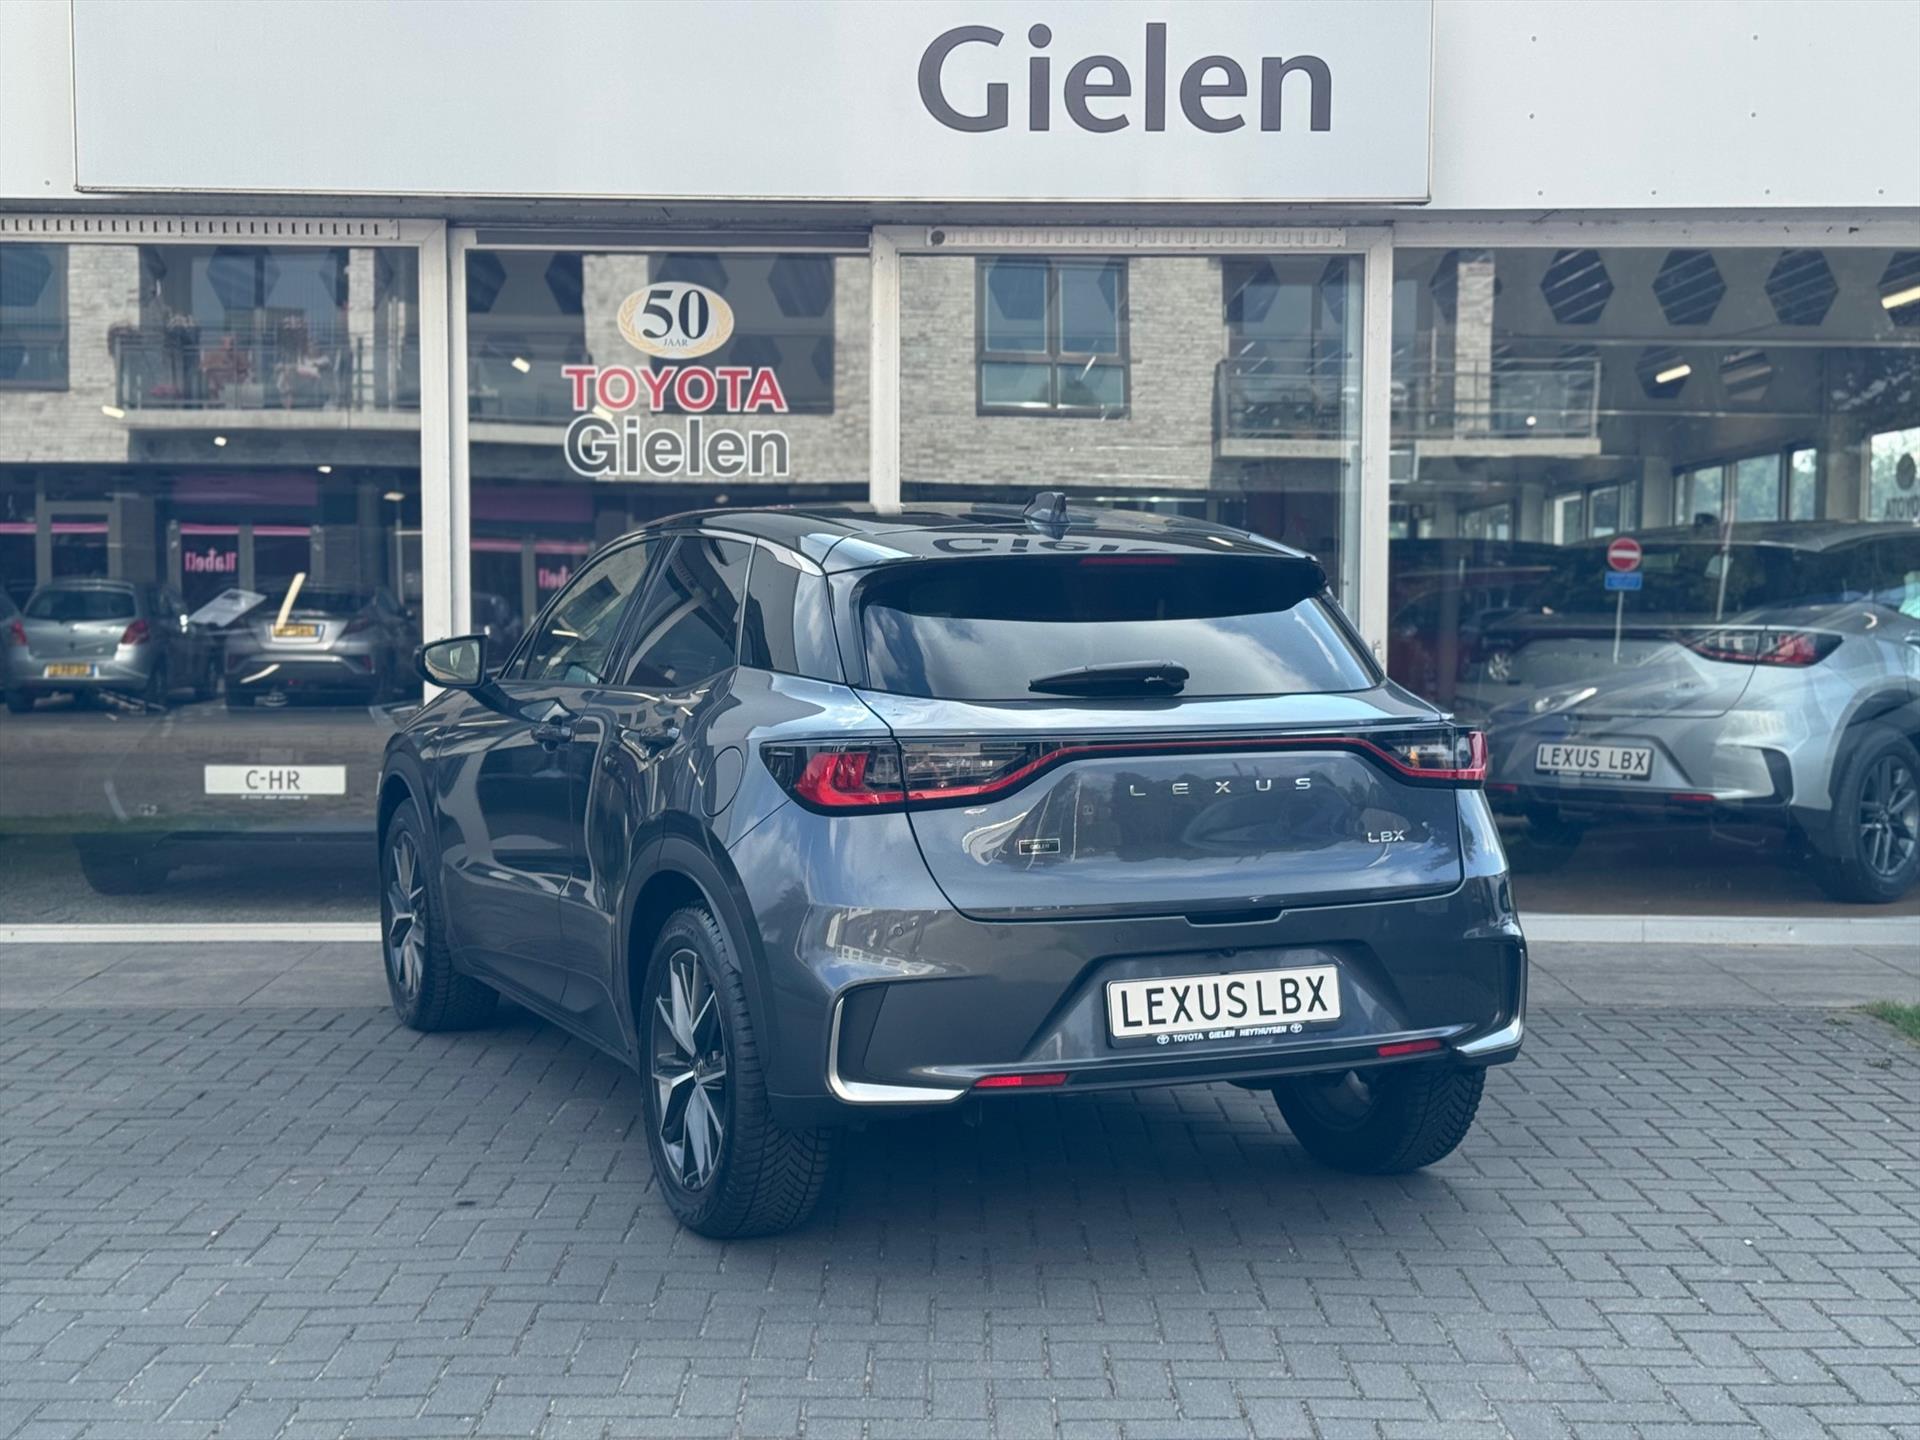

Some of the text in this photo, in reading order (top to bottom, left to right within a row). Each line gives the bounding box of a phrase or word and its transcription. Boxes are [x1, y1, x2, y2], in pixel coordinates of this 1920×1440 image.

[918, 23, 1332, 133] Gielen
[642, 289, 710, 340] 50
[664, 338, 688, 348] JAAR
[562, 366, 788, 412] TOYOTA
[564, 414, 790, 477] Gielen
[1540, 746, 1648, 772] LEXUS LBX
[245, 769, 301, 791] C-HR
[1129, 777, 1311, 796] LEXUS
[1367, 829, 1405, 843] LBX
[1172, 1033, 1204, 1043] TOYOTA
[1208, 1029, 1236, 1039] GIELEN
